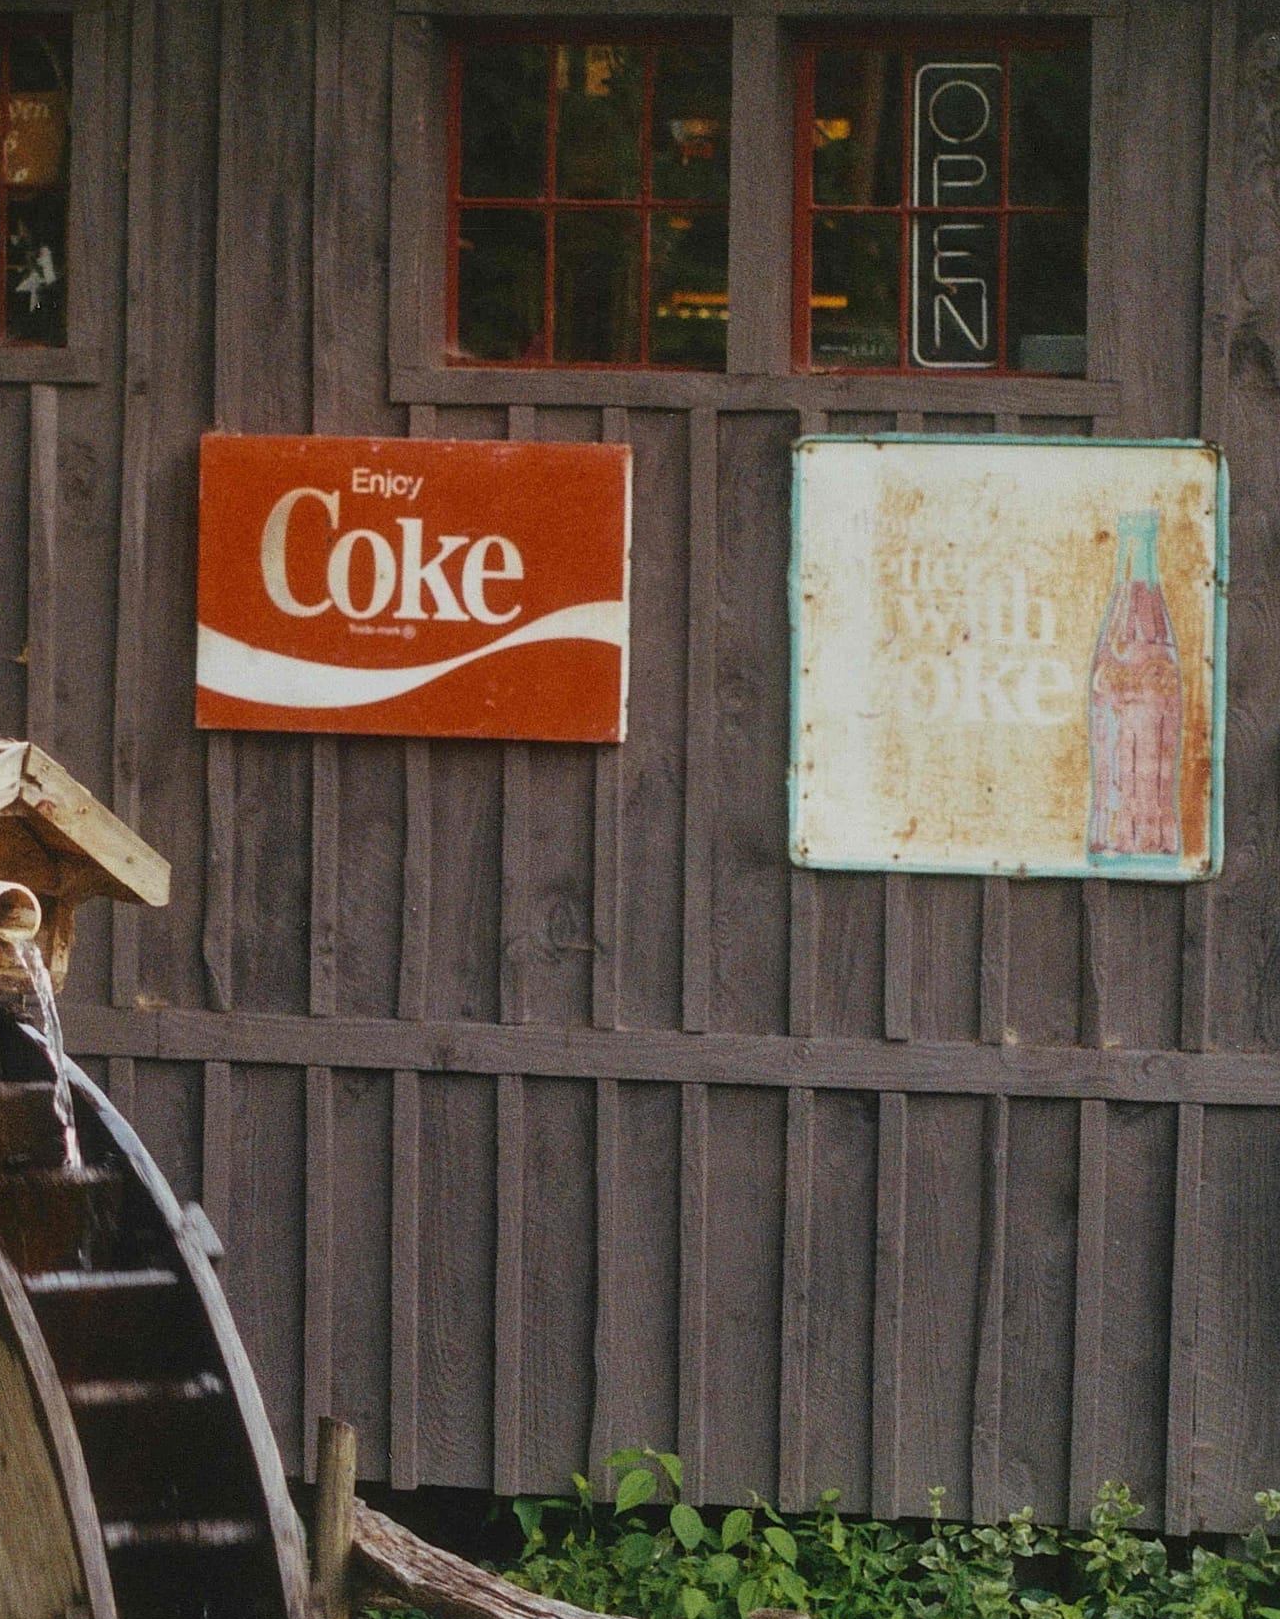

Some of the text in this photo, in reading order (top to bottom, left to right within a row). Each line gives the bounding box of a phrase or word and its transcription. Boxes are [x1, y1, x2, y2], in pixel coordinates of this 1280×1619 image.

[929, 80, 989, 350] OPEN
[351, 468, 424, 499] Enjoy
[260, 487, 524, 625] Coke
